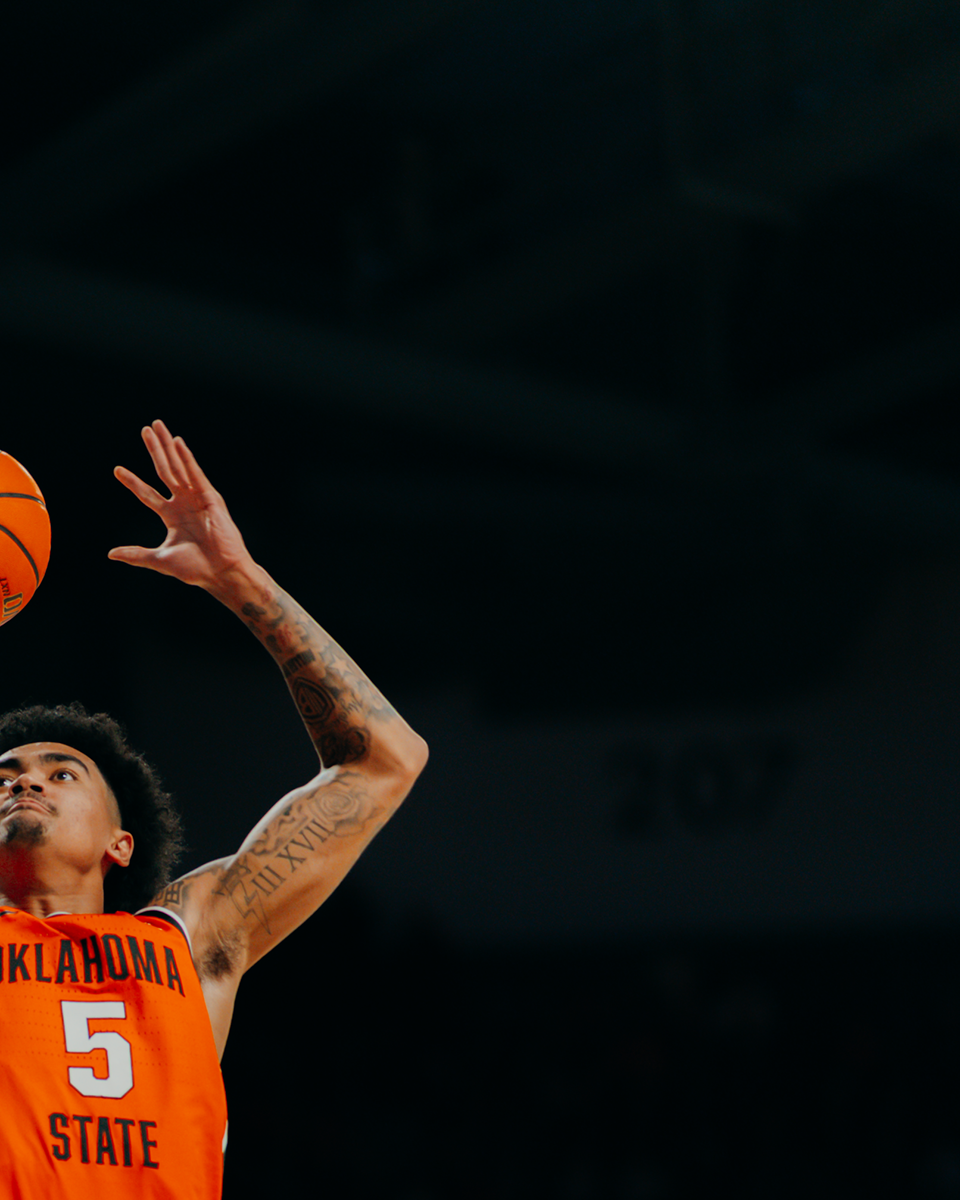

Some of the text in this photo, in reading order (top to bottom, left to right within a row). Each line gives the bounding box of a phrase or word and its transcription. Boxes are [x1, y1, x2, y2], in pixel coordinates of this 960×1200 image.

[602, 731, 803, 841] 207
[60, 1000, 134, 1099] 5
[48, 1112, 159, 1169] STATE
